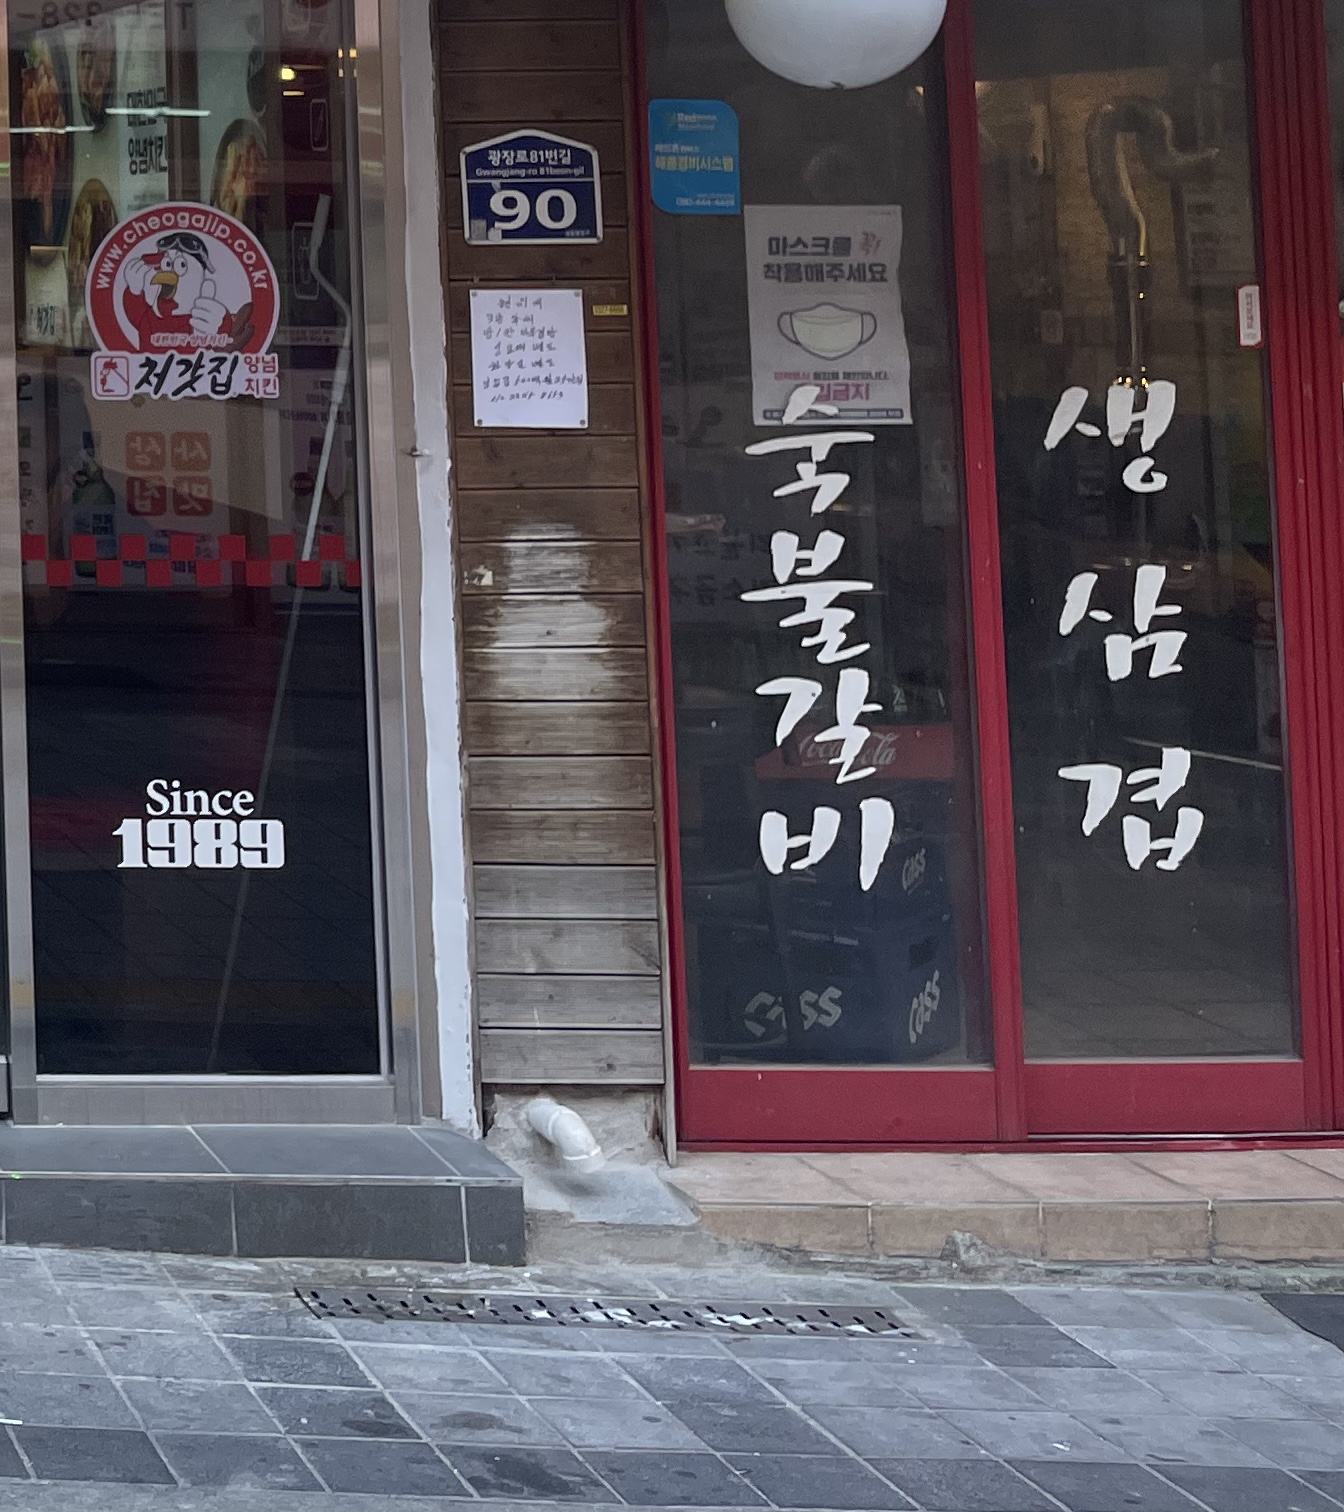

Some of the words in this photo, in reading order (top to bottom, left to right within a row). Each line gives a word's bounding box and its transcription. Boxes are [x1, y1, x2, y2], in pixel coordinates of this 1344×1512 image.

[490, 189, 577, 230] 90
[96, 211, 268, 290] www.cheogajip.co.kr
[768, 237, 852, 256] 마스크를
[135, 352, 238, 396] 처갓집
[244, 356, 278, 373] 양념
[244, 378, 278, 396] 치킨
[1044, 381, 1204, 871] 생삼겹
[146, 779, 255, 816] Since
[113, 818, 285, 869] 1989
